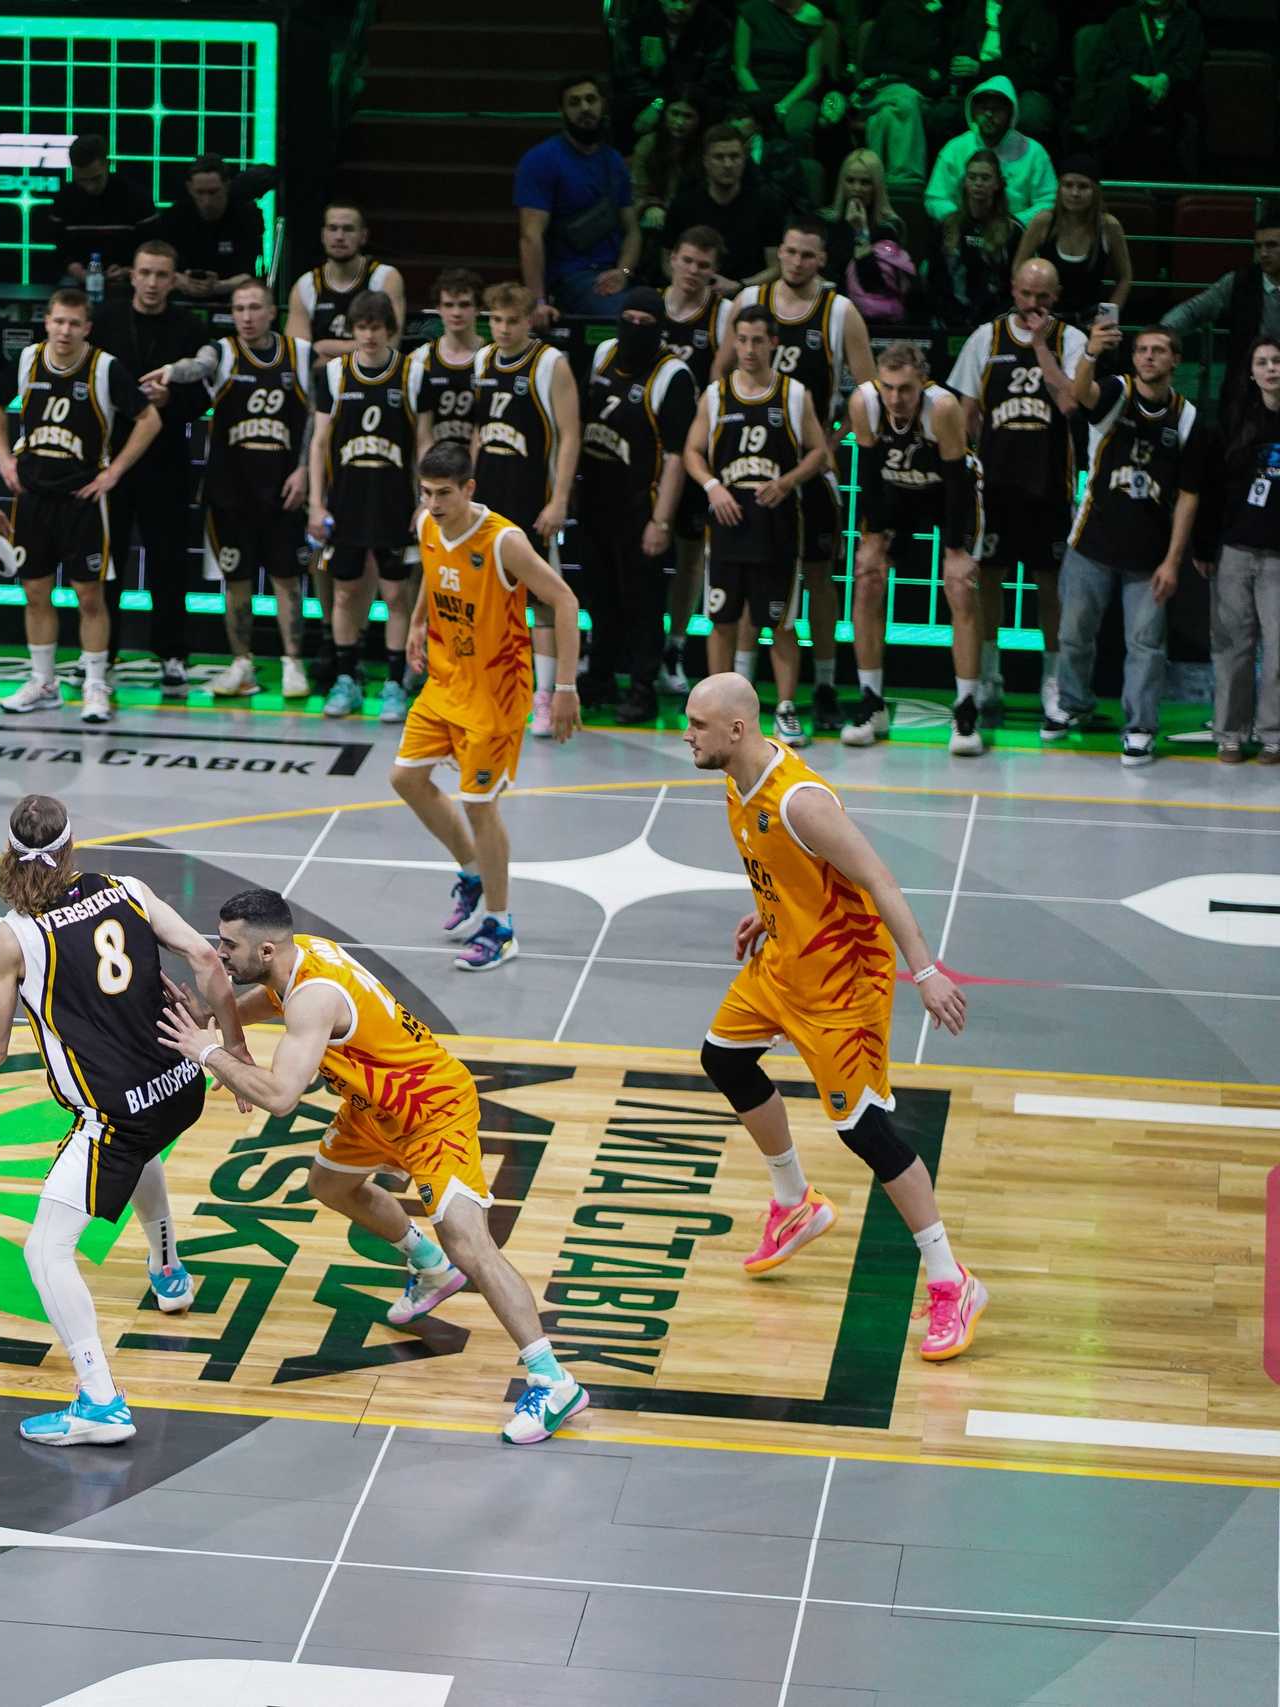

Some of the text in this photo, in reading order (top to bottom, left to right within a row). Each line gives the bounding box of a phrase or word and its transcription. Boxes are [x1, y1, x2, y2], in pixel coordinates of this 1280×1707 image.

[1007, 366, 1043, 394] 23
[41, 396, 71, 423] 10
[246, 388, 286, 415] 69
[489, 391, 514, 419] 17
[599, 394, 621, 420] 7
[361, 405, 382, 432] 0
[738, 425, 768, 454] 19
[438, 565, 461, 592] 25
[35, 884, 129, 933] VERSHKOV
[93, 918, 133, 996] 8
